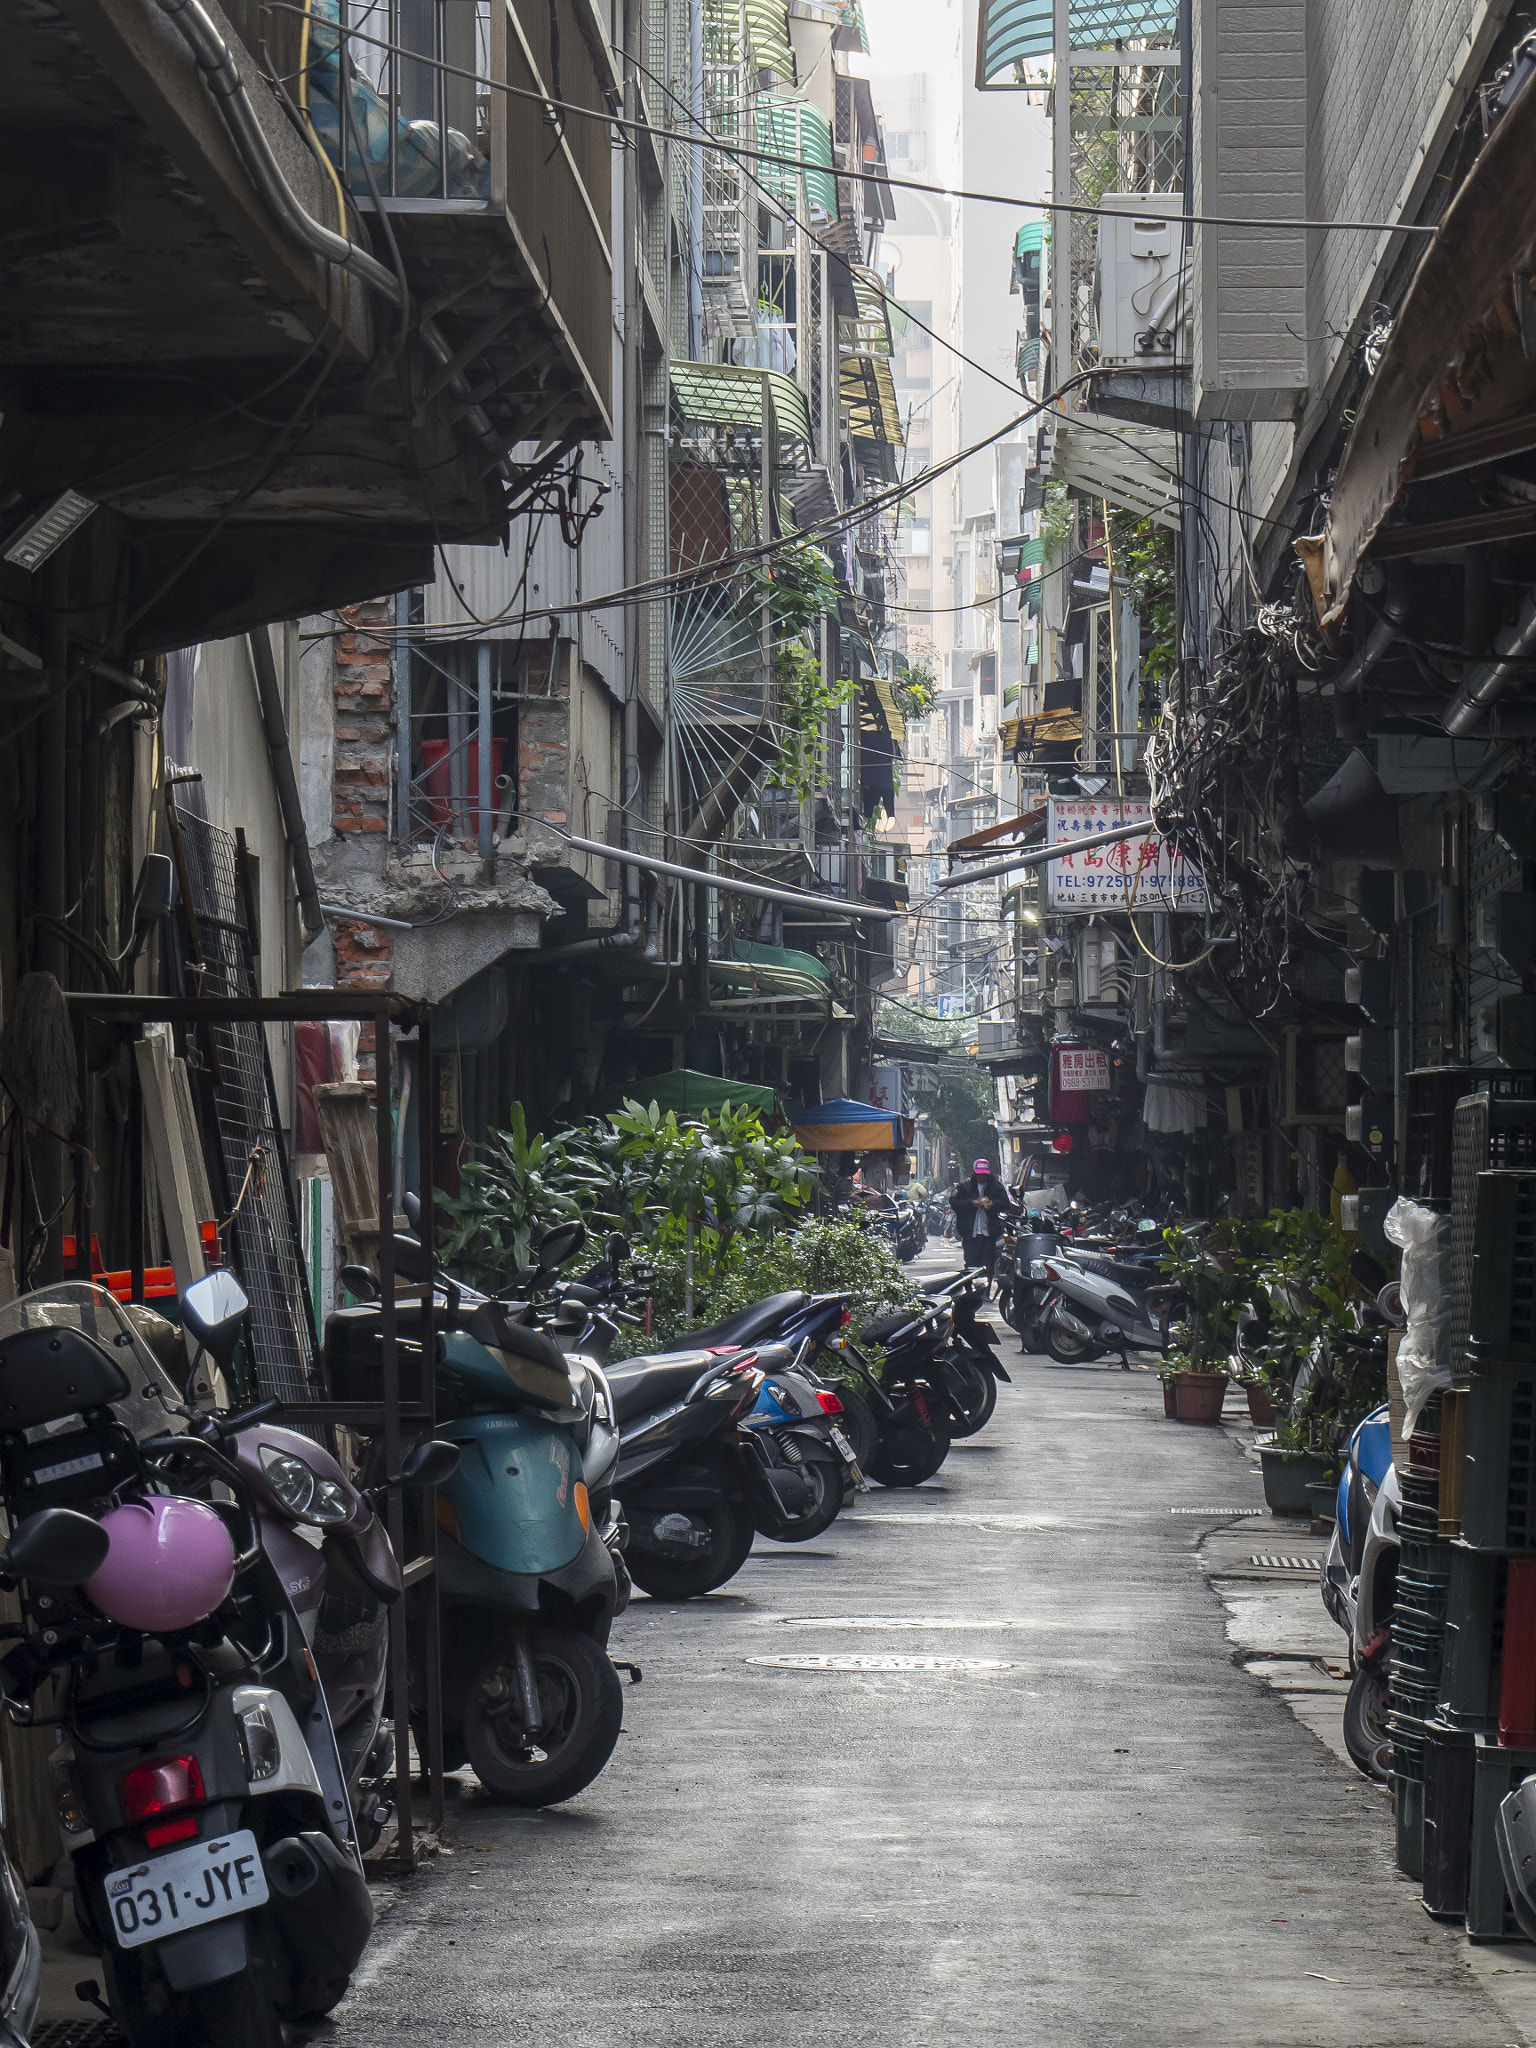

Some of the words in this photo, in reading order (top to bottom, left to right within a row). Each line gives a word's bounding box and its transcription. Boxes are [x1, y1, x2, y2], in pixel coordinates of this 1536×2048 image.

[1062, 1053, 1108, 1069] 雅房出租
[484, 1420, 519, 1430] YAMAHA
